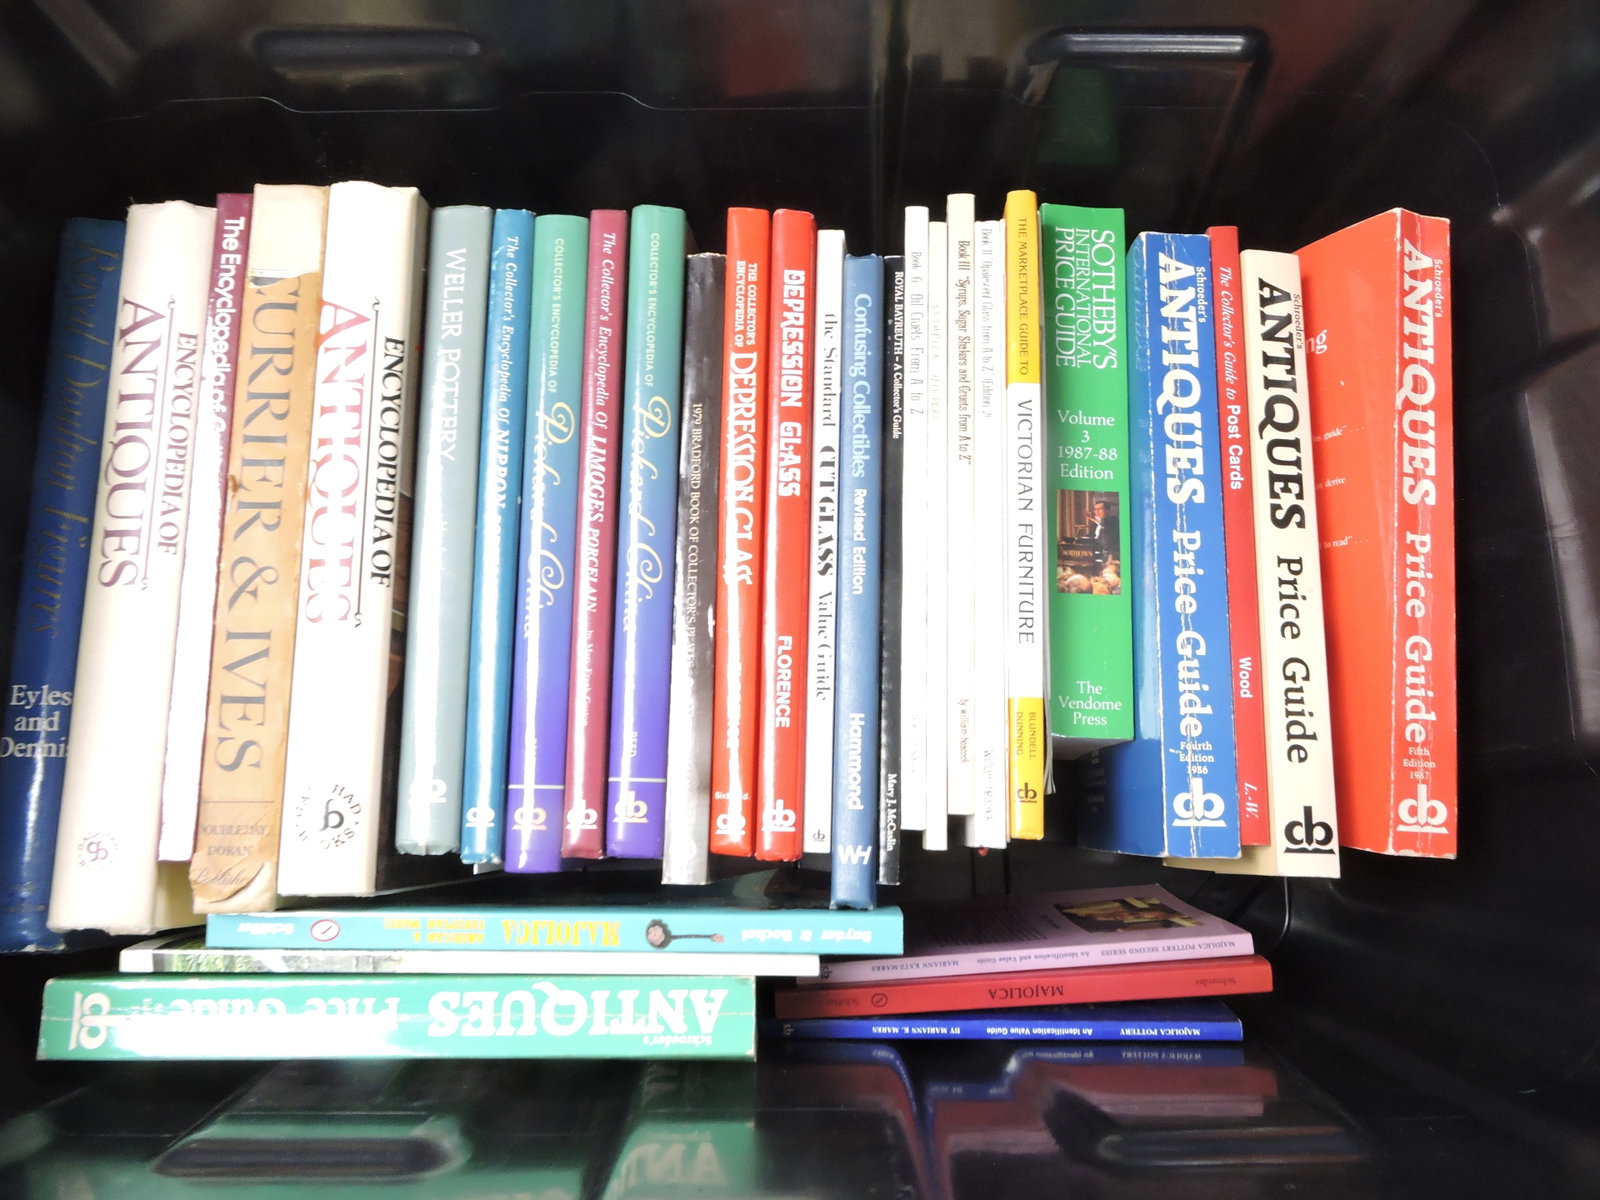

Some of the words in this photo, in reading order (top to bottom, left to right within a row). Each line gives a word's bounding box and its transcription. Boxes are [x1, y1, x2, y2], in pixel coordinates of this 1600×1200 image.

[220, 216, 246, 251] The
[506, 235, 520, 258] The
[603, 232, 617, 255] The
[957, 240, 971, 259] Book
[1018, 218, 1028, 238] THE
[551, 238, 565, 300] COLLECTOR'S
[649, 233, 661, 295] COLLECTOR'S
[747, 263, 758, 282] THE
[1055, 226, 1076, 289] PRICE
[1219, 266, 1233, 287] The
[440, 247, 466, 340] WELLER
[503, 262, 518, 321] Collector's
[600, 259, 616, 321] Collector's
[735, 260, 746, 331] ENCYCLOPEDIA
[894, 271, 904, 303] ROYAL
[1018, 241, 1029, 320] MARKETPLACE
[1075, 228, 1092, 369] INTERNATIONAL
[1090, 228, 1118, 370] SOTHEBY'S
[1196, 266, 1208, 324] Schroeder's
[1433, 258, 1445, 318] Schroeder's
[208, 253, 241, 390] Encyclopedia
[645, 297, 658, 371] ENCYCLOPEDIA
[746, 284, 758, 346] COLLECTOR'S
[848, 293, 873, 378] Confusing
[893, 304, 904, 355] BAYREUTH
[955, 310, 971, 334] Sugar
[1055, 293, 1076, 368] GUIDE
[1222, 291, 1238, 349] Collector's
[1292, 293, 1305, 350] Schroeder's
[548, 303, 561, 377] ENCYCLOPEDIA
[734, 334, 744, 348] OF
[780, 269, 805, 407] DEPRESSION
[1019, 323, 1029, 356] GUIDE
[497, 325, 514, 402] Encyclopedia
[594, 326, 613, 406] Encyclopedia
[644, 374, 655, 388] OF
[893, 362, 903, 371] A
[958, 368, 971, 383] and
[1019, 360, 1030, 376] TO
[1156, 251, 1206, 505] ANTIQUES
[1223, 352, 1238, 385] Guide
[1396, 237, 1437, 506] ANTIQUES
[437, 348, 462, 462] POTTERY
[547, 380, 558, 393] OF
[822, 347, 838, 428] Standard
[892, 372, 902, 413] Collector's
[1225, 389, 1237, 400] to
[1257, 276, 1307, 530] ANTIQUES
[159, 332, 199, 517] ENCYCLOPEDIA
[232, 275, 302, 543] CURRIER
[496, 407, 511, 425] Of
[594, 411, 609, 430] Of
[691, 402, 703, 425] 1979
[852, 380, 872, 479] Collectibles
[892, 414, 901, 439] Guide
[958, 414, 971, 432] from
[1056, 409, 1115, 427] Volume
[1227, 404, 1243, 440] Post
[97, 297, 166, 589] ANTIQUES
[372, 336, 406, 544] ENCYCLOPEDIA
[690, 428, 703, 479] BRADFORD
[958, 434, 971, 442] A
[958, 444, 969, 452] to
[1017, 399, 1034, 511] VICTORIAN
[1057, 446, 1118, 461] 1987-88
[1081, 430, 1091, 443] 3
[304, 298, 371, 624] ANTIQUES
[494, 430, 511, 509] NIPPON
[589, 434, 608, 523] LIMOGES
[778, 421, 802, 497] GLASS
[1060, 463, 1115, 481] Edition
[1230, 444, 1245, 490] Cards
[689, 491, 701, 524] BOOK
[852, 488, 867, 543] Revised
[157, 521, 181, 556] OF
[687, 526, 699, 543] OF
[817, 496, 835, 577] GLASS
[227, 556, 280, 616] &
[369, 549, 393, 589] OF
[686, 545, 699, 623] COLLECTOR'S
[852, 546, 866, 595] Edition
[1018, 523, 1035, 645] FURNITURE
[1173, 529, 1205, 615] Price
[1405, 530, 1434, 618] Price
[817, 591, 833, 640] Value
[1276, 555, 1308, 641] Price
[775, 635, 792, 728] FLORENCE
[816, 644, 833, 702] Guide
[1076, 680, 1104, 695] The
[1176, 629, 1214, 738] Guide
[1238, 657, 1254, 699] Wood
[1405, 635, 1437, 745] Guide
[9, 684, 73, 709] Eyles
[214, 628, 273, 773] IVES
[1058, 695, 1122, 711] Vendome
[1281, 656, 1319, 764] Guide
[14, 711, 61, 732] and
[1073, 711, 1108, 727] Press
[847, 713, 865, 810] Hammond
[1179, 741, 1213, 751] Fourth
[1179, 752, 1216, 763] Edition
[1402, 758, 1436, 768] Edition
[885, 773, 898, 797] Mary
[1187, 765, 1210, 776] 1986
[885, 808, 897, 852] McCaslin
[501, 919, 622, 947] MAJOLICA
[1100, 949, 1128, 957] SERIES
[1128, 946, 1160, 955] SECOND
[1161, 943, 1196, 953] POTTERY
[1197, 940, 1236, 953] MAJOLICA
[427, 981, 729, 1037] ANTIQUES
[987, 983, 1065, 1002] MAJOLICA
[911, 1026, 948, 1035] MARIANN
[950, 1027, 961, 1035] BY
[986, 1027, 1009, 1037] Guide
[1010, 1027, 1031, 1037] Value
[1032, 1027, 1081, 1037] Identification
[1081, 1028, 1093, 1036] An
[1120, 1027, 1158, 1037] POTTERY
[1160, 1027, 1201, 1036] MAJOLICA
